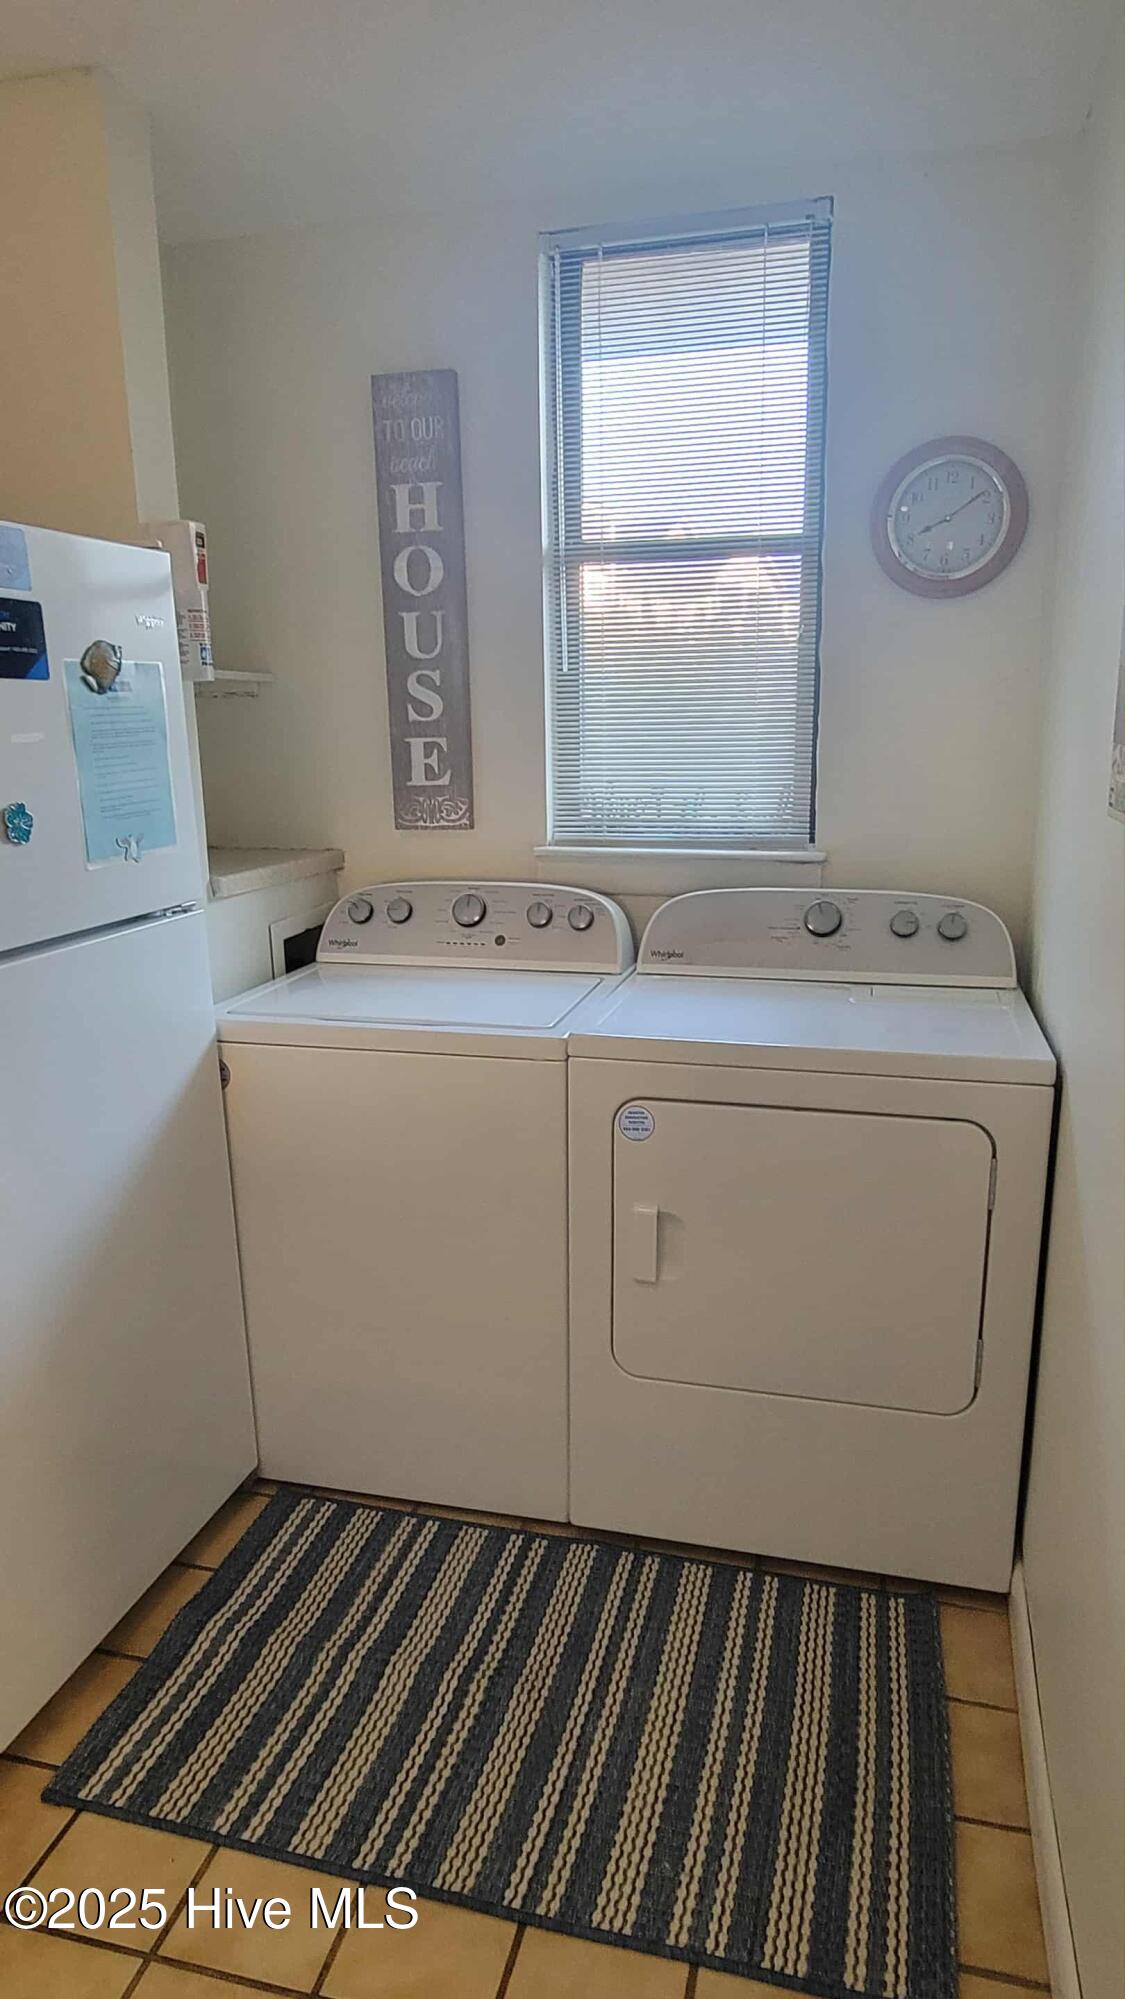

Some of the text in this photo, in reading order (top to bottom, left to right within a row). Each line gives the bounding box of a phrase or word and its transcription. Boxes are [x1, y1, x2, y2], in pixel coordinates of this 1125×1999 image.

[383, 415, 444, 442] TO OUR
[390, 481, 451, 787] HOUSE
